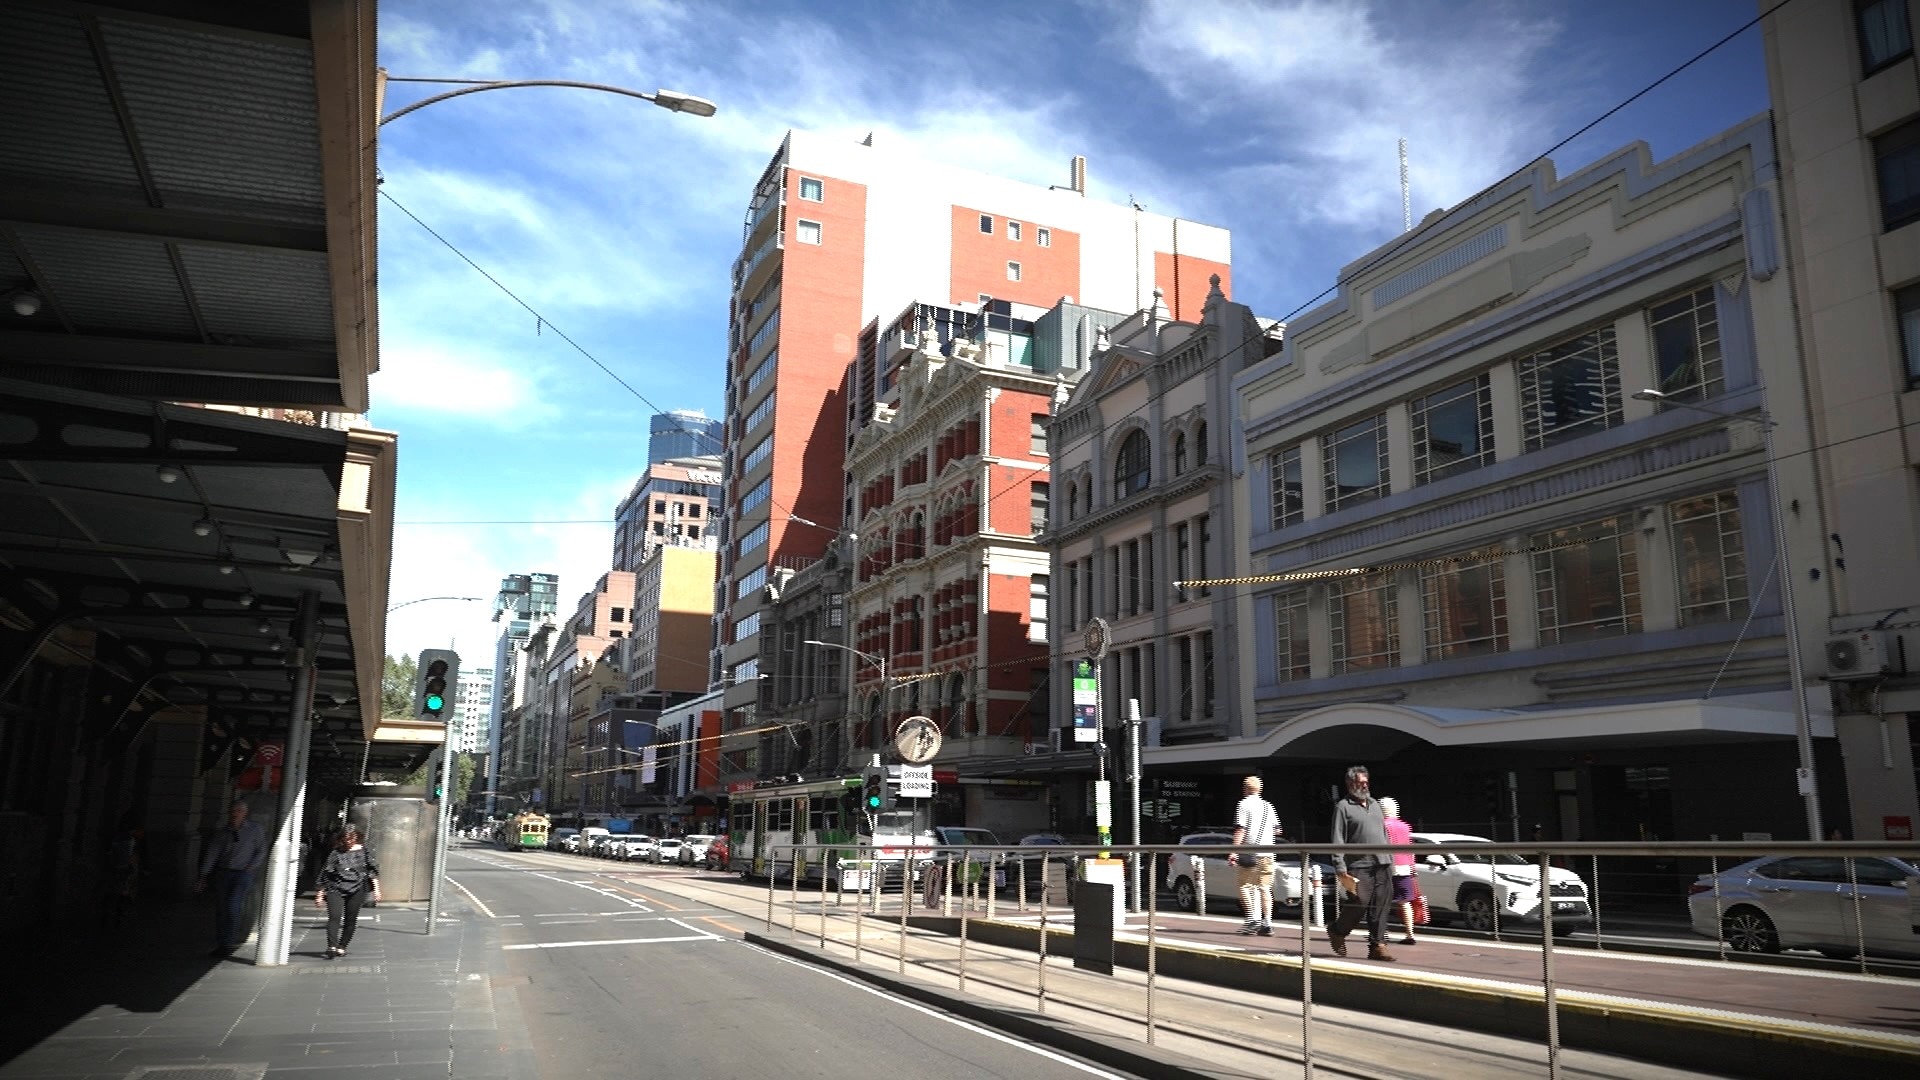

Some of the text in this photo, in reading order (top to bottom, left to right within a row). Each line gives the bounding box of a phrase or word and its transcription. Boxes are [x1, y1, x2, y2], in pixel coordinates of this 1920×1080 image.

[903, 771, 929, 780] OFFSIDE
[902, 782, 930, 790] LOADING
[1163, 780, 1198, 789] SUBWAY
[1161, 790, 1201, 798] TO STATION
